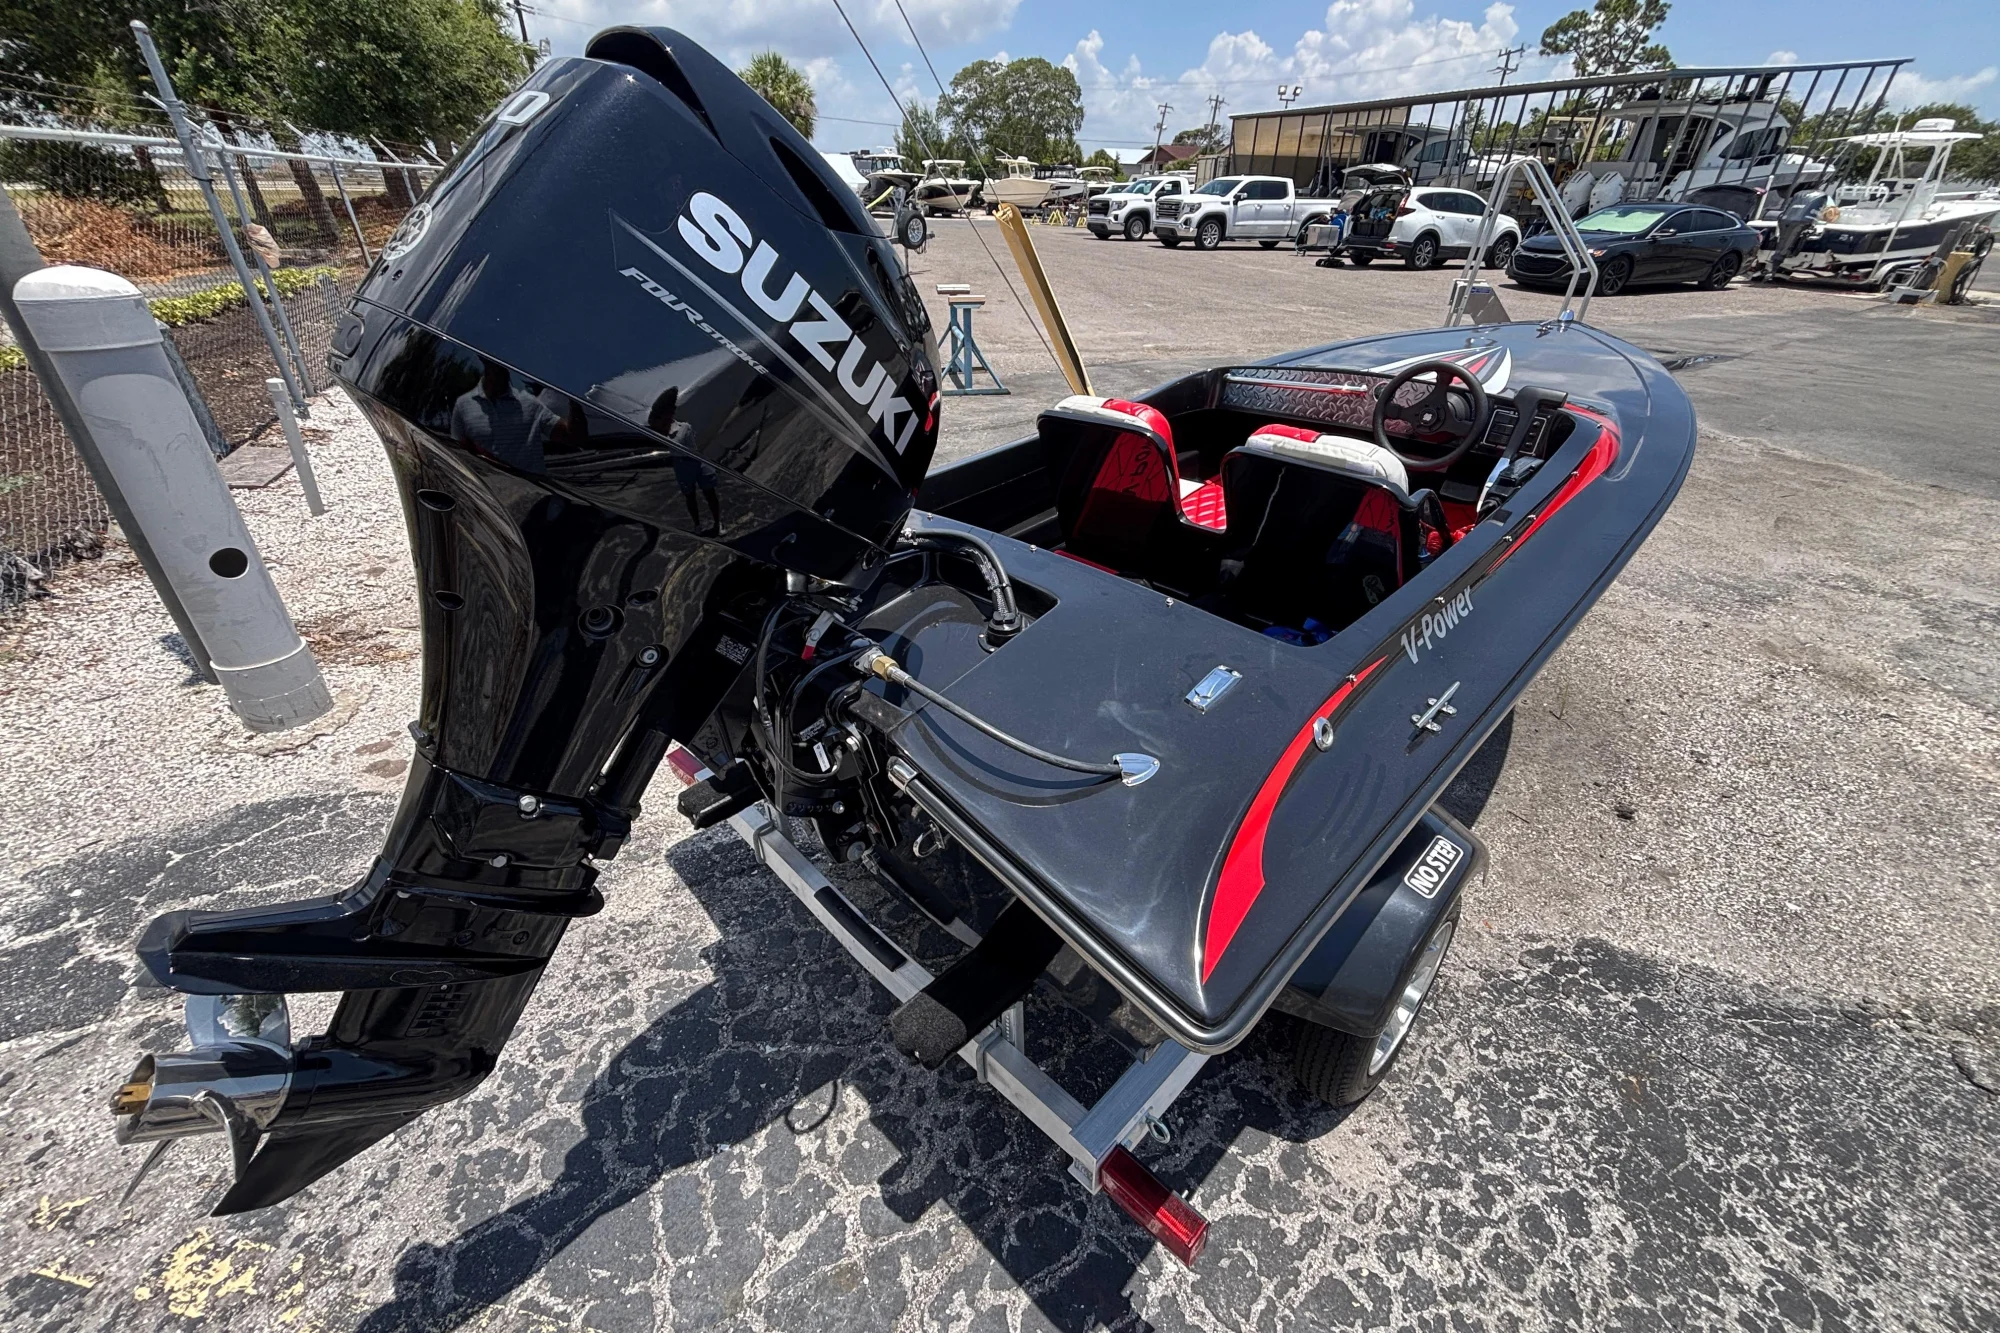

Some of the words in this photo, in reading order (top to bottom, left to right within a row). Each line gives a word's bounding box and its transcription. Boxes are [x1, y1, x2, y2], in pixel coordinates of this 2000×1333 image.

[677, 191, 919, 457] SUZUKI
[1400, 585, 1474, 665] V-Power
[1409, 865, 1439, 894] NO
[1426, 840, 1457, 873] STEP
